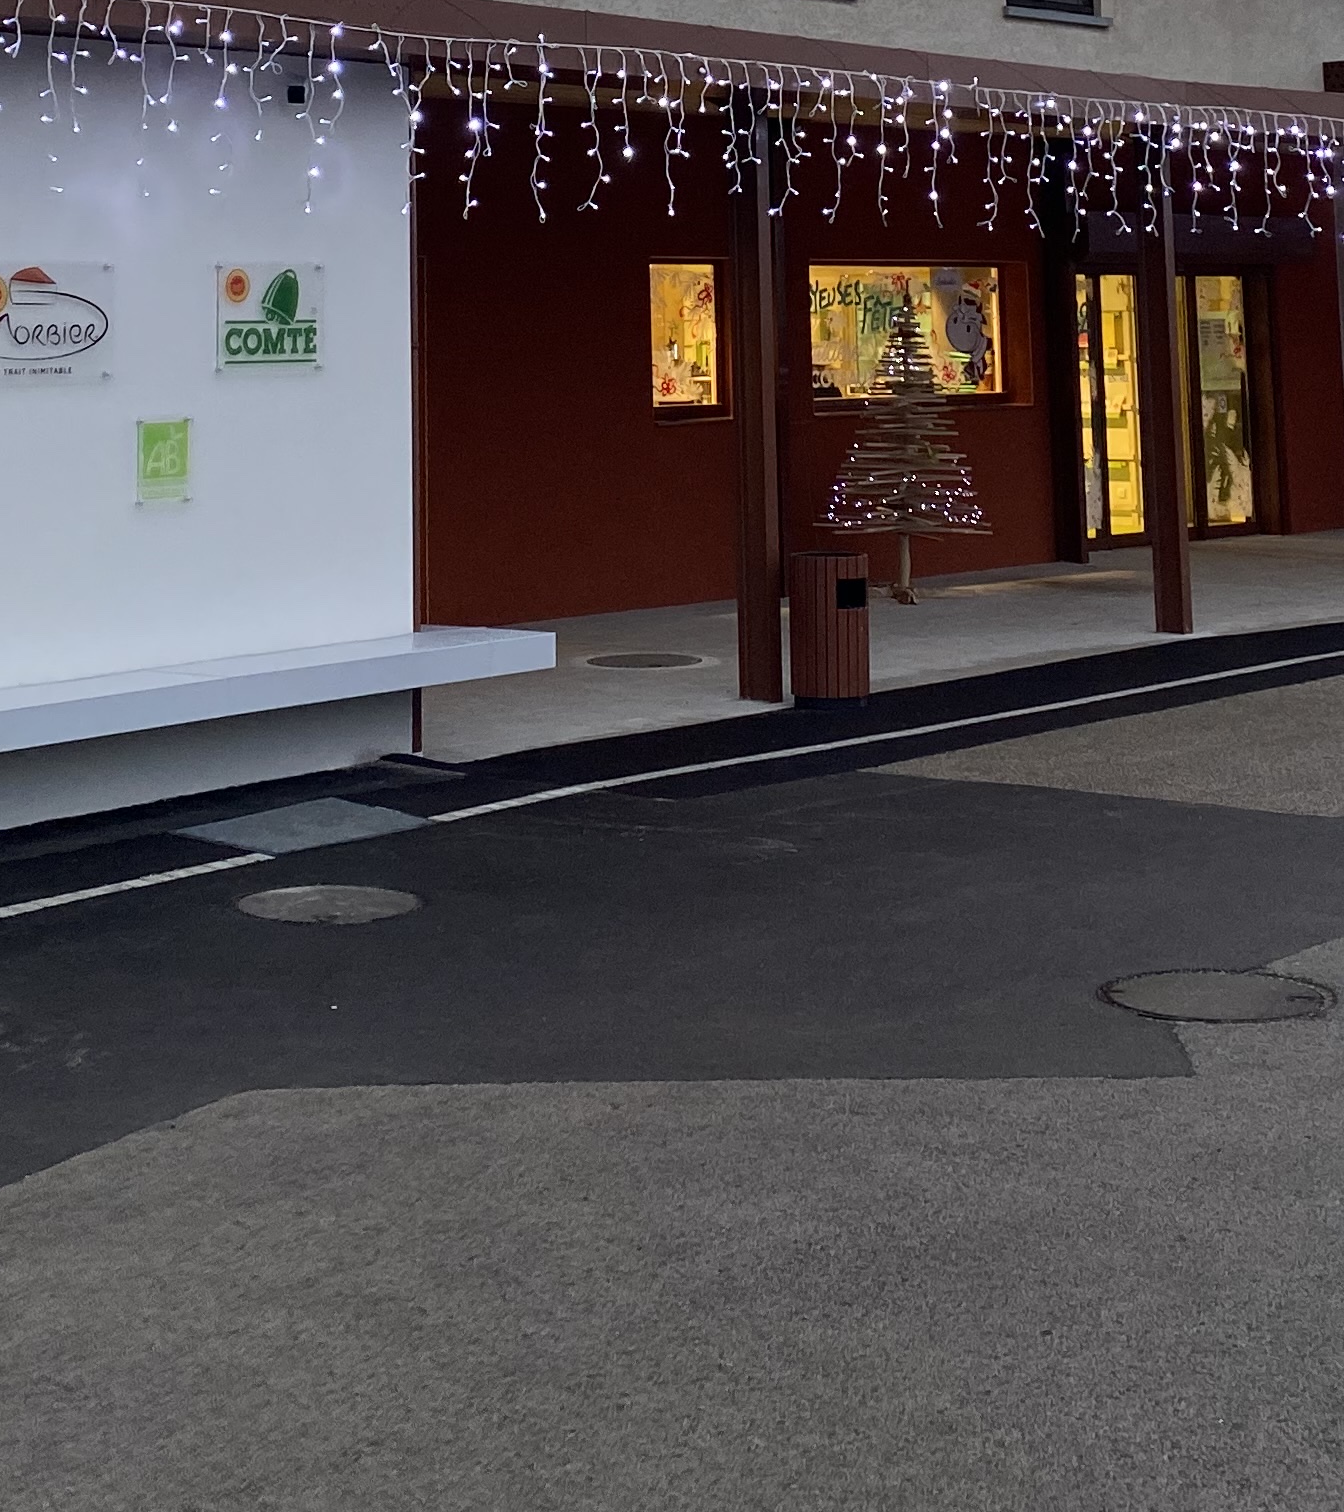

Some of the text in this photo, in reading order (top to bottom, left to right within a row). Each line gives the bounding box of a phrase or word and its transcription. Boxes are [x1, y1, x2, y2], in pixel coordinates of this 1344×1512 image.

[809, 279, 862, 315] YEUSES
[225, 324, 317, 356] COMTÉ
[3, 367, 26, 376] TRAIT
[145, 439, 181, 476] AB
